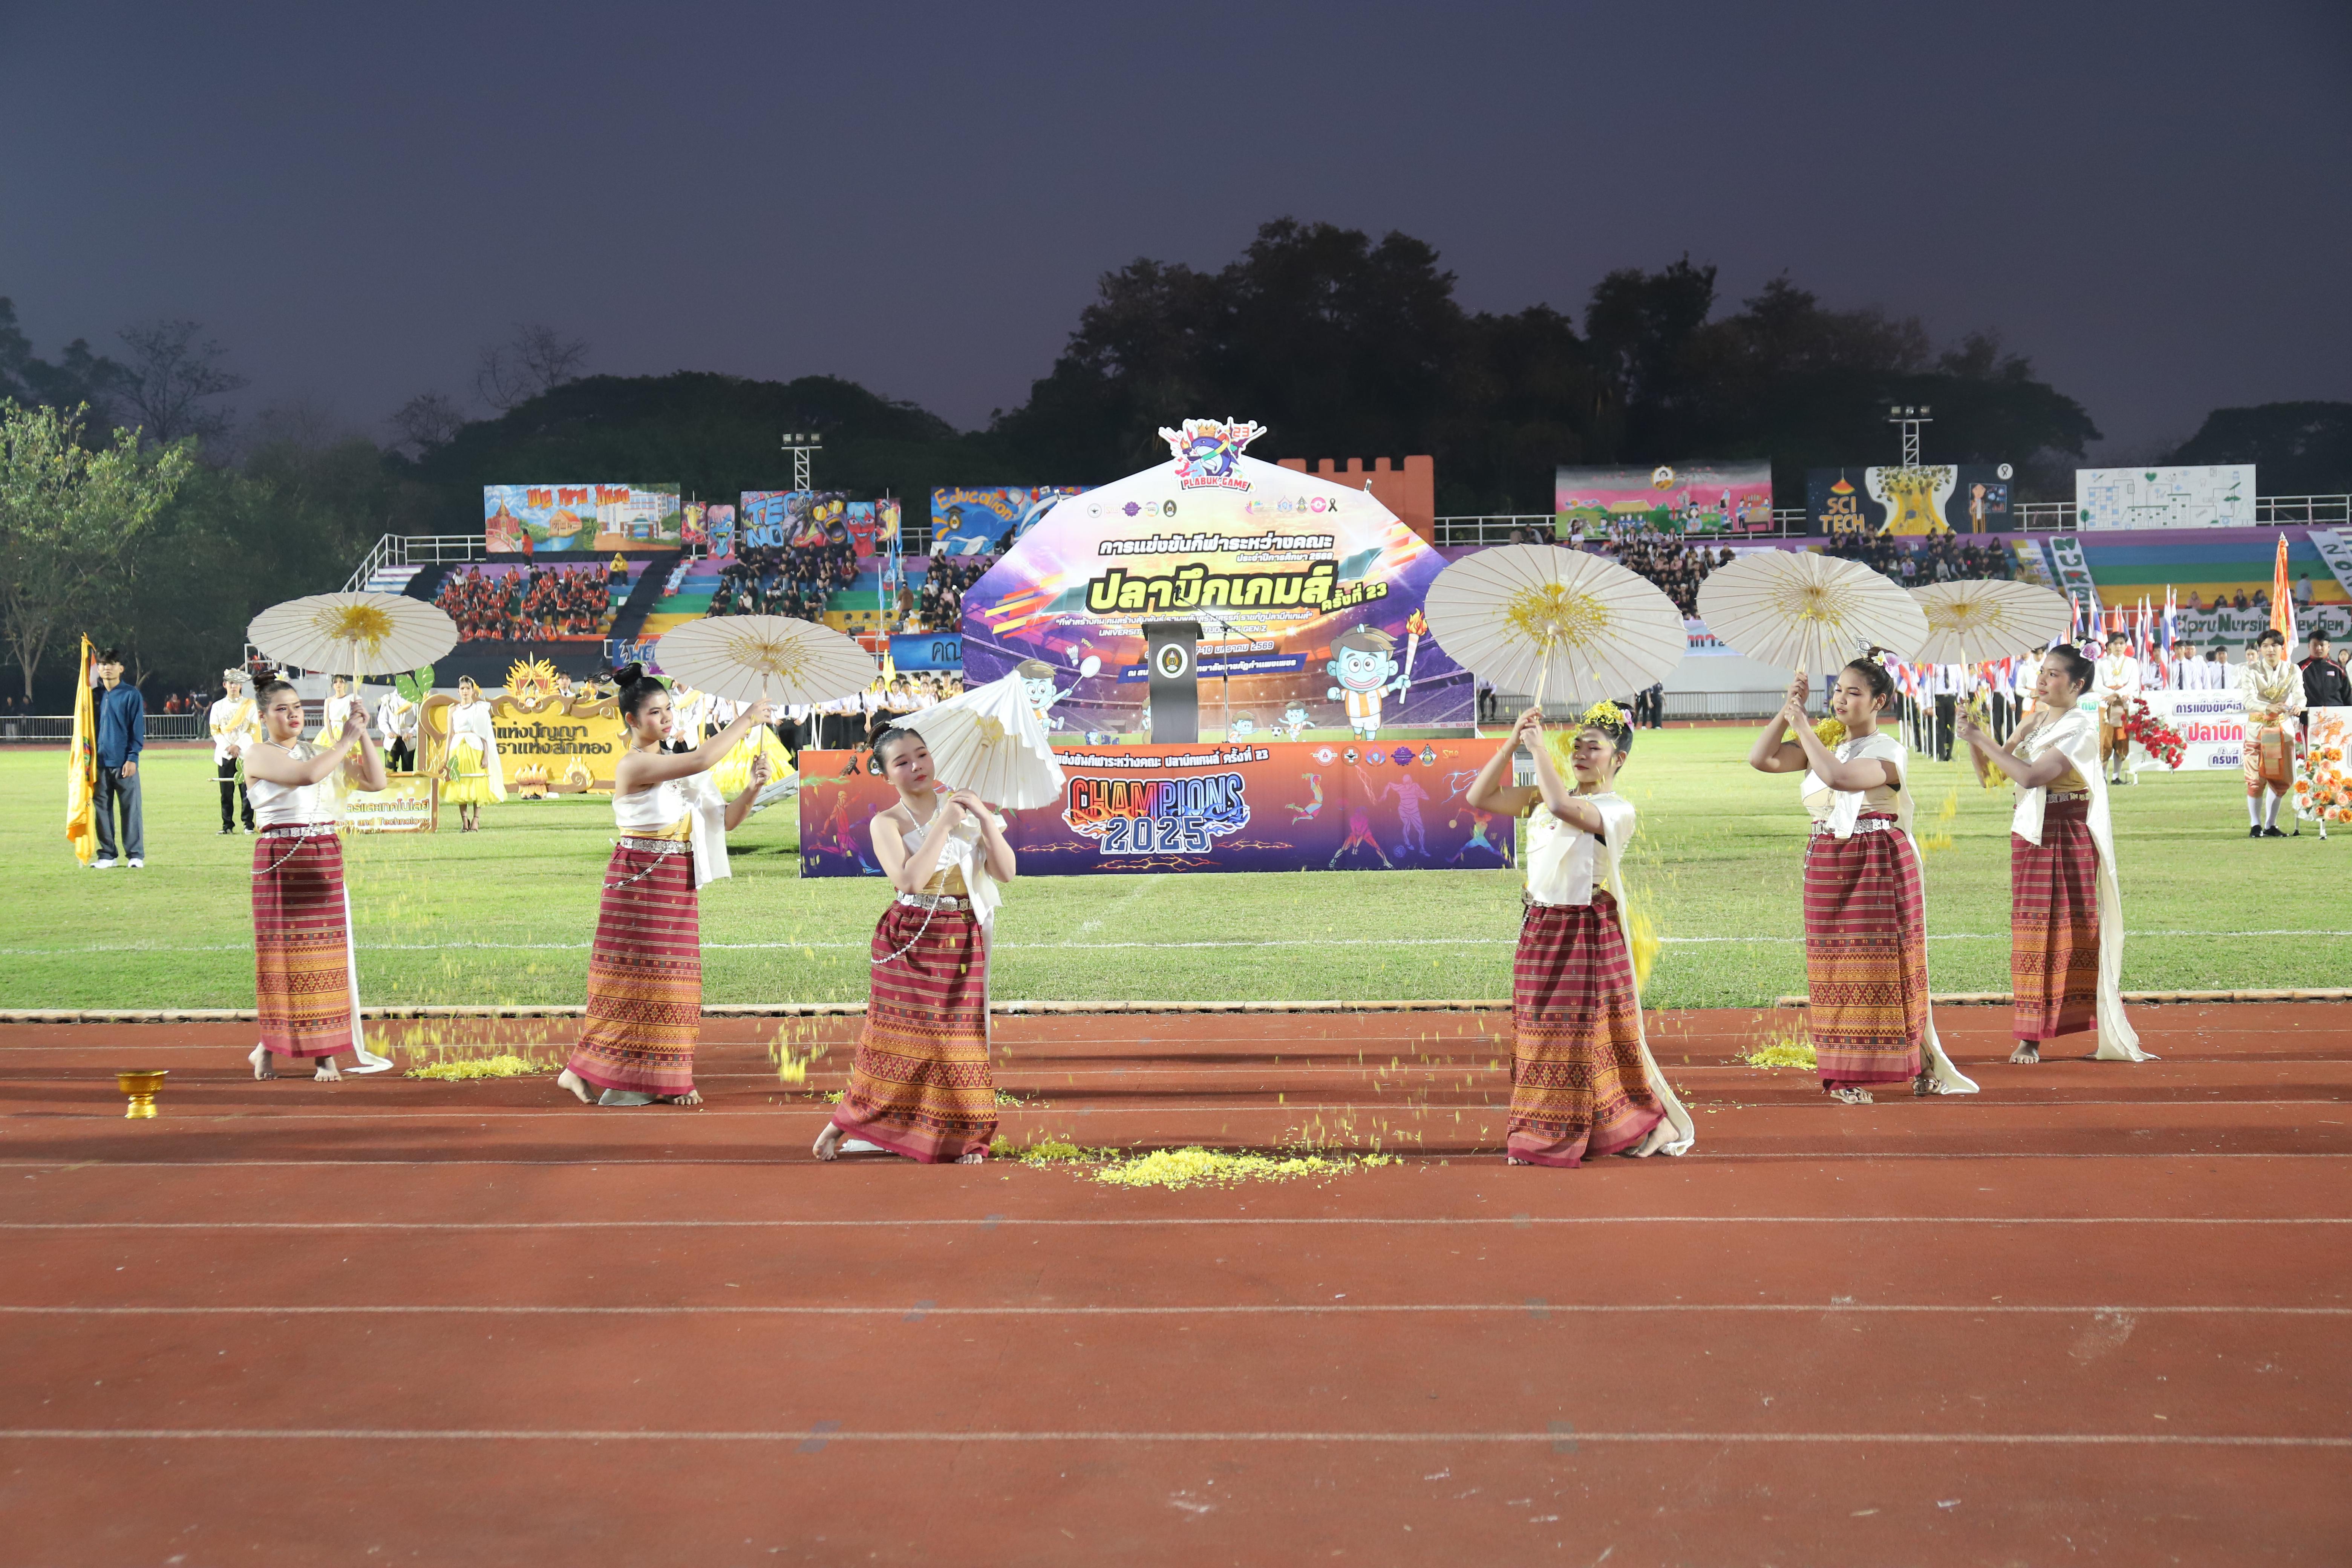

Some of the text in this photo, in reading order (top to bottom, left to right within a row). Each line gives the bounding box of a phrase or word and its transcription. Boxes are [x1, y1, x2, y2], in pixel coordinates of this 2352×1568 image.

[1233, 427, 1249, 437] 23
[1183, 476, 1249, 489] PLABUK GAME
[935, 487, 1013, 521] Education
[1827, 496, 1857, 514] SCI
[1819, 513, 1865, 533] TECH
[1099, 532, 1334, 554] การแข่งขันกีฬาระหว่างคณะ
[1236, 552, 1308, 562] ประจำปีการศึกษา
[1090, 565, 1388, 612] ปลาบึกเกมส์ ครั้งที่ 23
[1251, 641, 1274, 651] 2569
[1223, 745, 1253, 764] ครั้งที่
[1255, 749, 1269, 761] 23
[2212, 748, 2239, 764] ครั้งที่
[1071, 774, 1243, 819] CHAMPIONS
[358, 817, 375, 826] and
[1105, 816, 1209, 852] 2025
